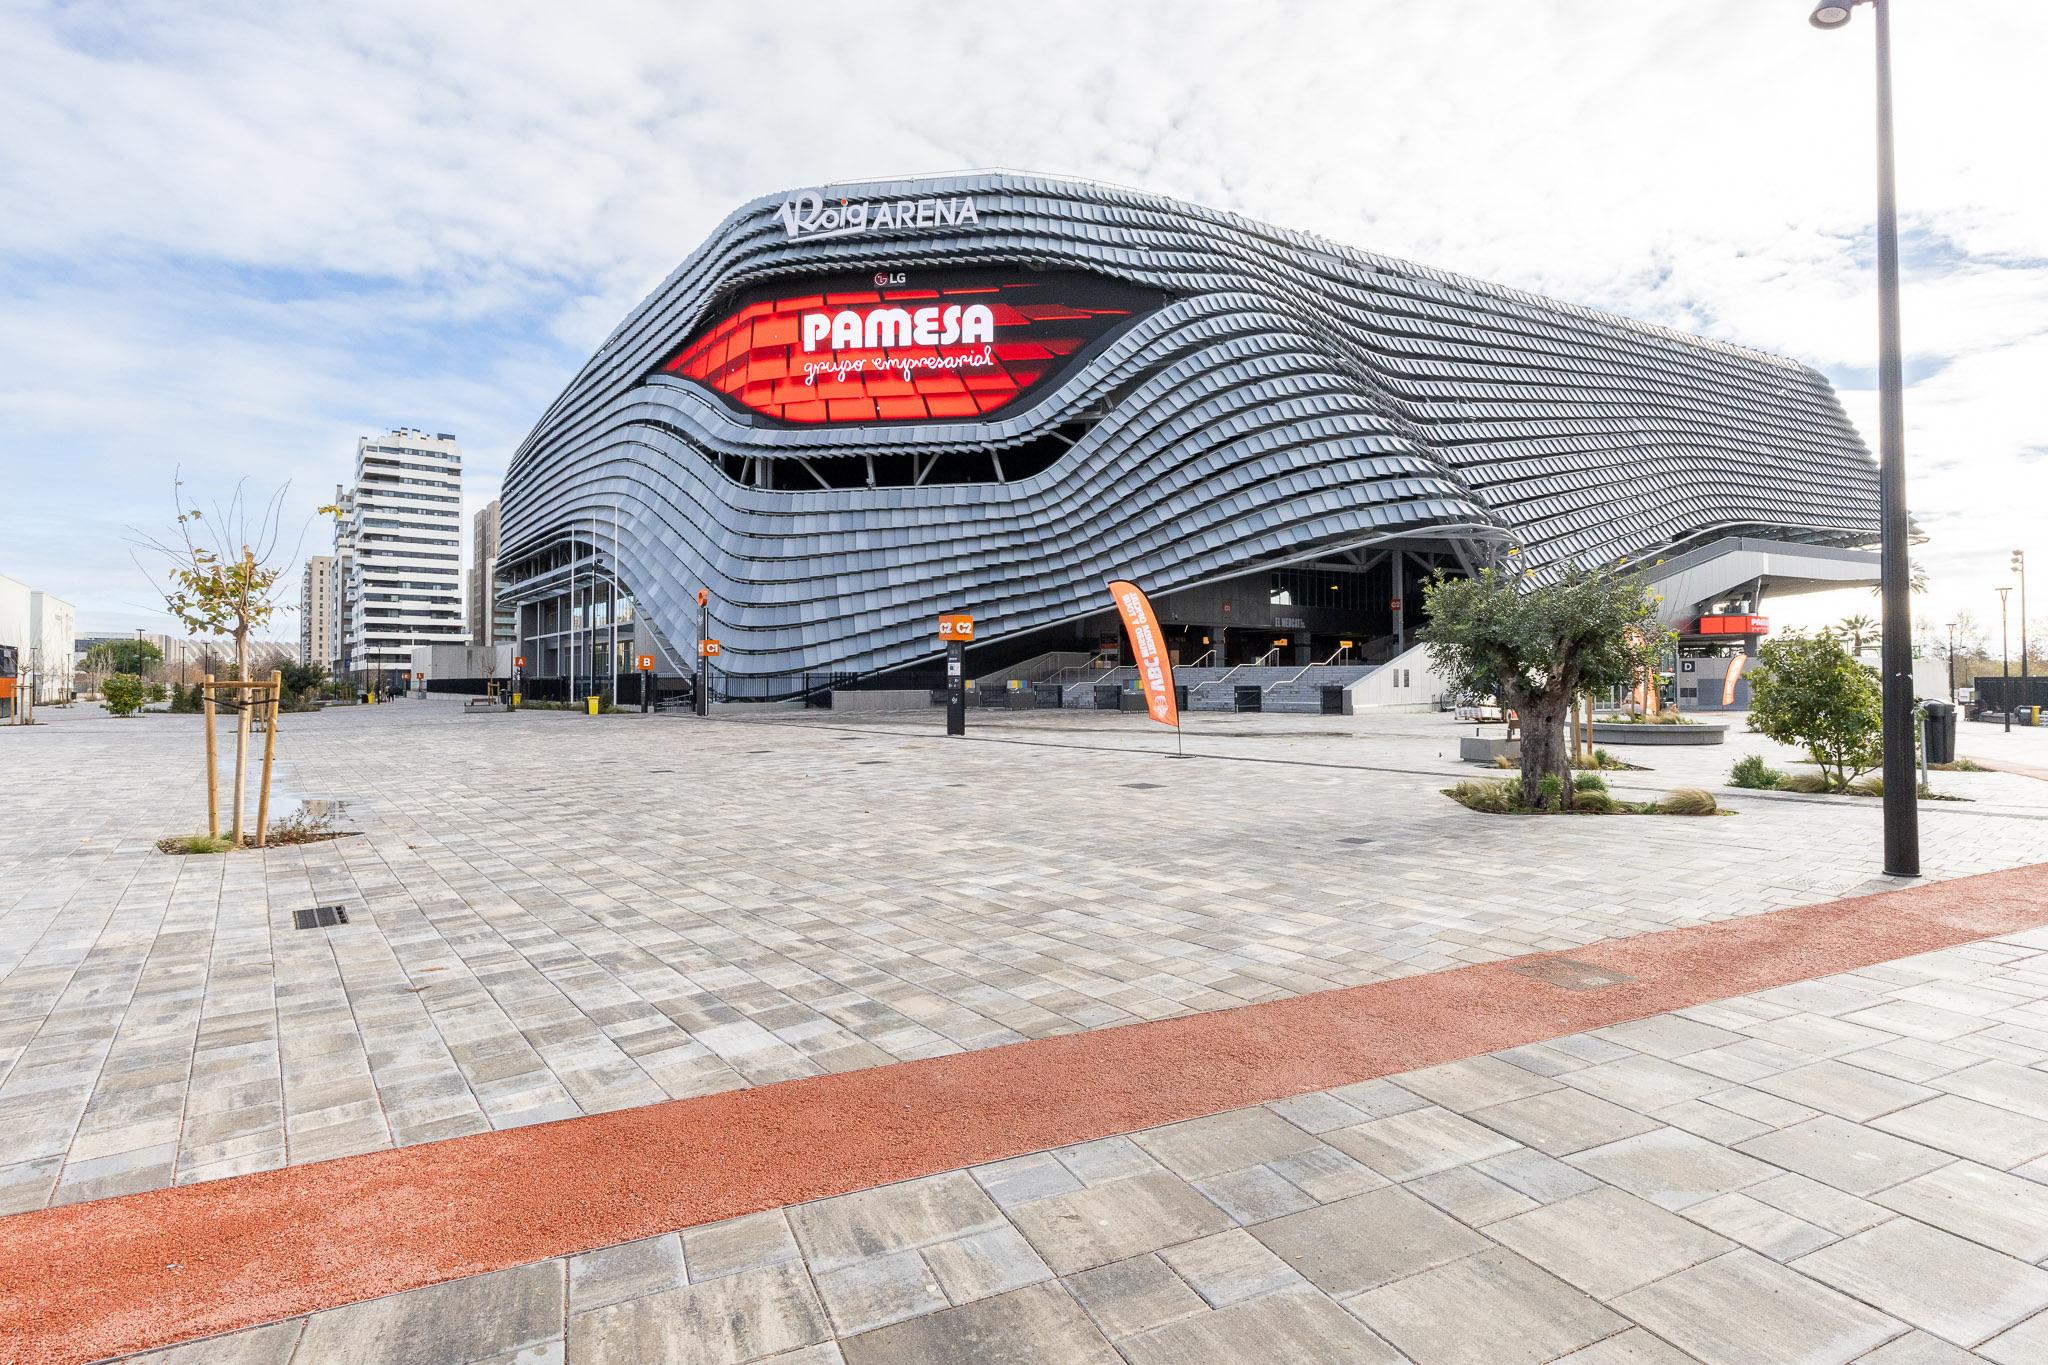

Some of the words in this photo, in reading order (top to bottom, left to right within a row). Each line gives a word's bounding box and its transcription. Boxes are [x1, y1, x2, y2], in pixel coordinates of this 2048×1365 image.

[773, 190, 869, 243] Roig
[872, 196, 980, 230] ARENA
[890, 273, 906, 284] LG
[803, 304, 994, 352] PAMESA
[803, 358, 867, 386] grupo
[872, 345, 994, 382] empresarial
[940, 622, 953, 634] C2
[956, 622, 972, 634] C2
[706, 643, 719, 653] C1
[643, 657, 651, 667] B
[1684, 662, 1692, 671] D
